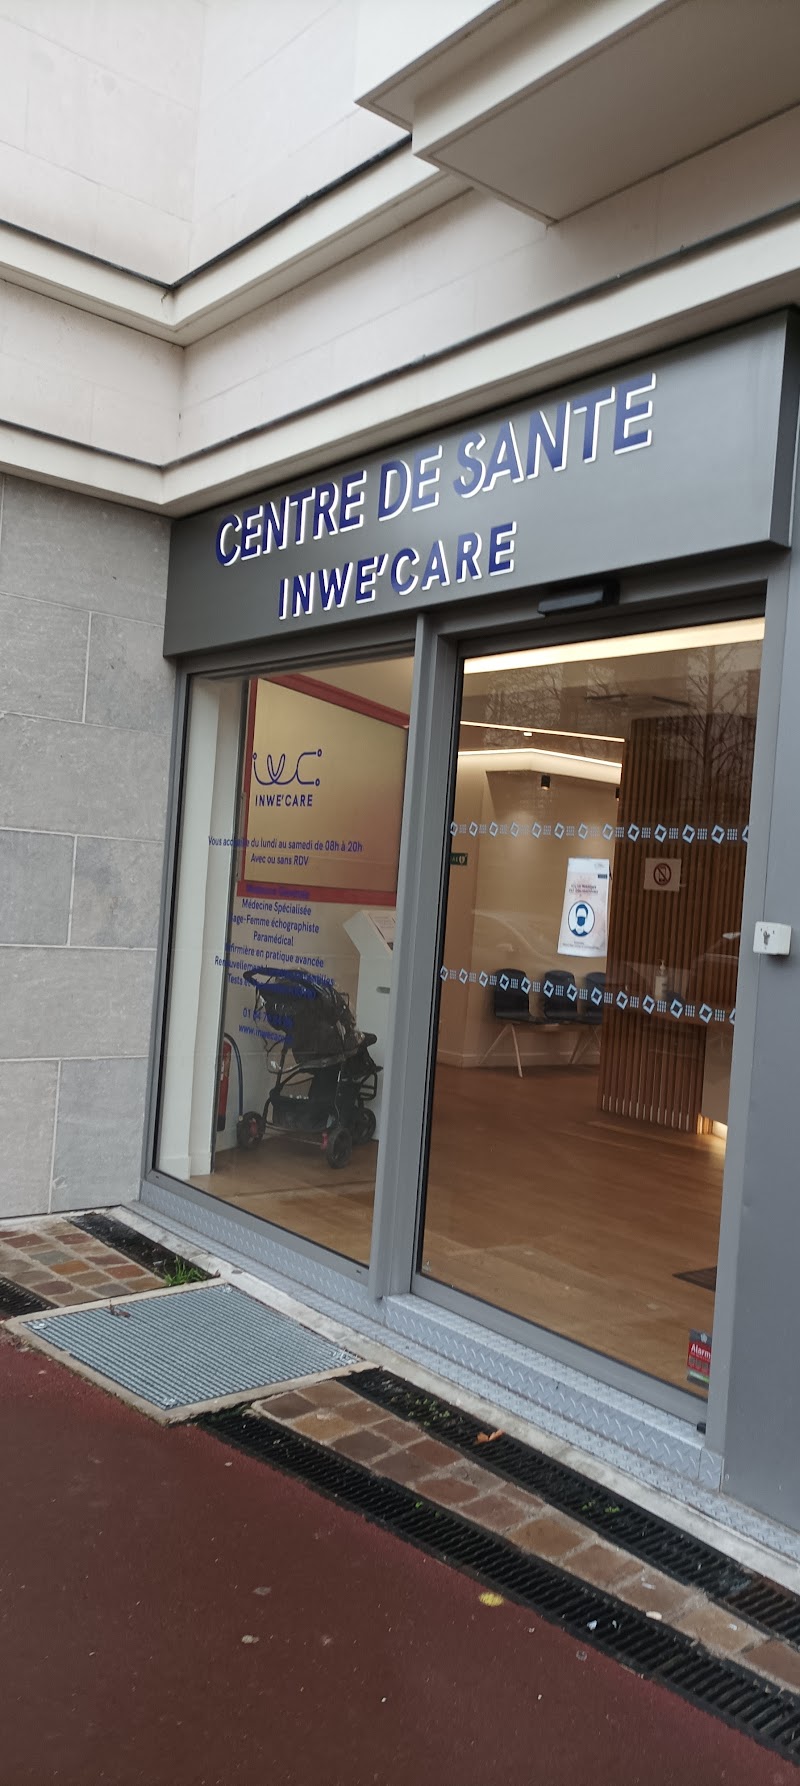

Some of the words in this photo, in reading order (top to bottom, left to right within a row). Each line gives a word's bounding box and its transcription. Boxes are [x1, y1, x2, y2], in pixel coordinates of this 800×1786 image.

[216, 470, 367, 566] CENTRE
[378, 445, 443, 521] DE
[453, 372, 657, 500] SANTE
[278, 521, 517, 620] INWE'CARE
[255, 794, 313, 807] INWE'CARE
[208, 836, 222, 847] Vous
[251, 837, 260, 847] du
[260, 838, 277, 848] lundi
[278, 841, 287, 849] au
[288, 839, 313, 850] samedi
[314, 840, 323, 851] de
[325, 840, 339, 851] 08h
[341, 841, 346, 851] à
[347, 841, 363, 852] 20h
[250, 853, 266, 864] Avec
[267, 855, 276, 864] ou
[277, 855, 292, 865] sans
[293, 856, 309, 866] RDV
[242, 898, 273, 911] Médecine
[274, 901, 312, 916] Spécialisée
[228, 912, 270, 927] age-Femme
[271, 916, 319, 934] échographiste
[253, 931, 294, 947] Paramédical
[255, 949, 264, 958] en
[265, 950, 294, 965] pratique
[295, 955, 324, 968] avancée
[227, 973, 243, 985] Tests
[691, 1344, 711, 1359] Alarm
